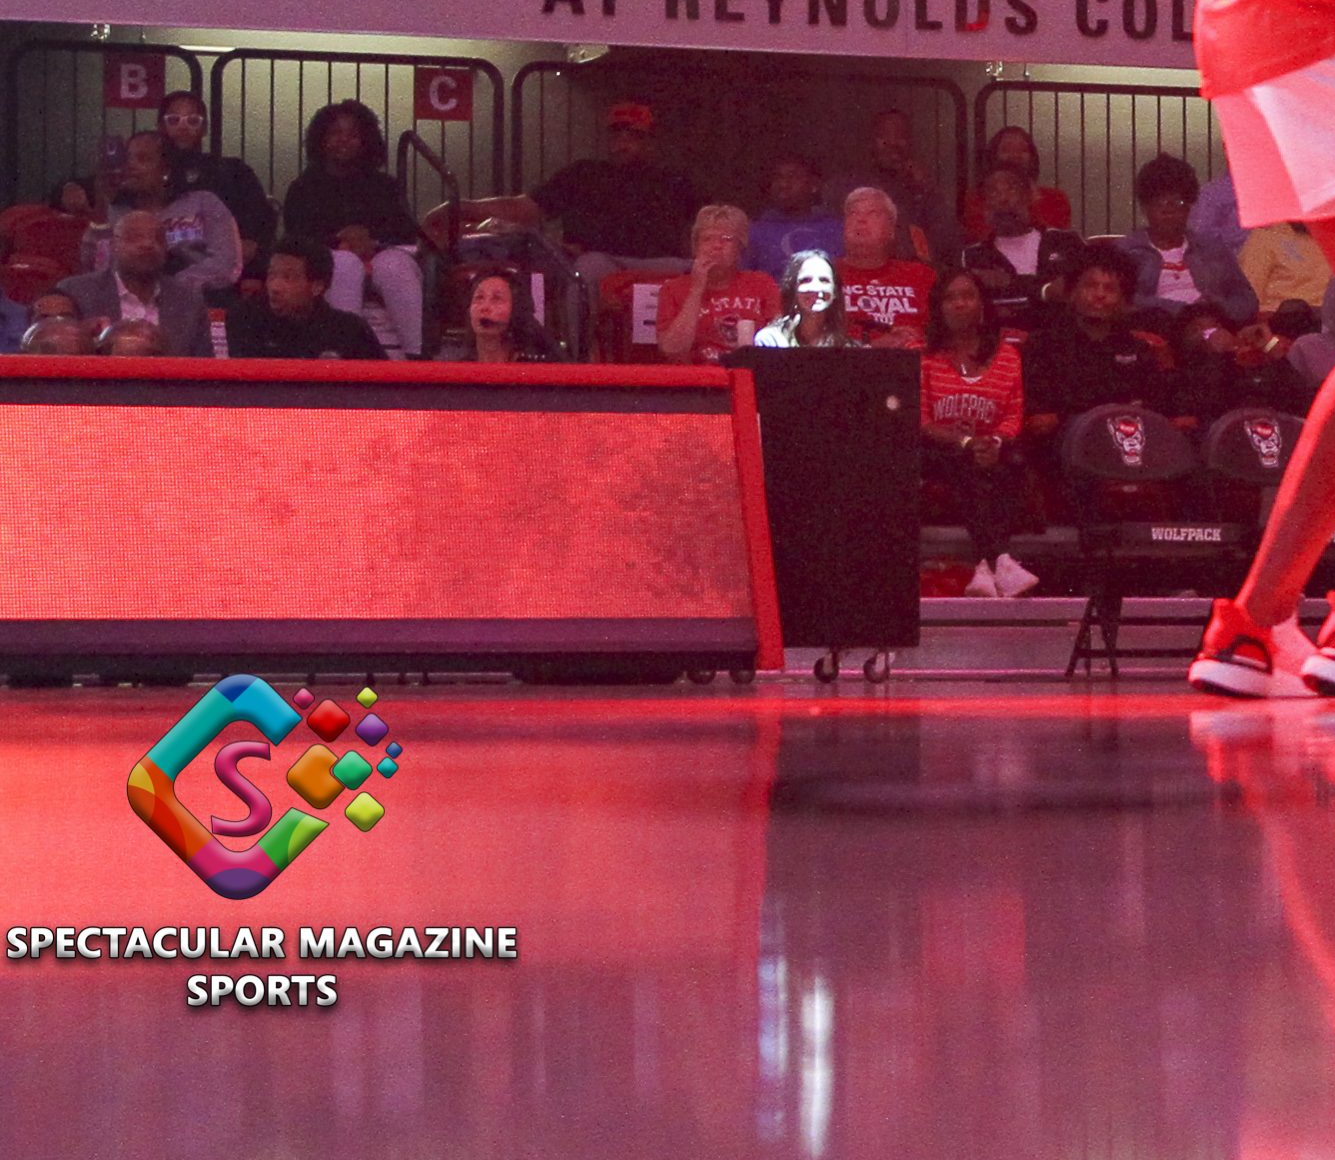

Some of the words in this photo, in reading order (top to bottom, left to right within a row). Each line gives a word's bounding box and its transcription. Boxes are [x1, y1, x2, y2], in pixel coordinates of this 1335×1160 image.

[121, 63, 149, 100] B
[429, 75, 458, 111] C
[866, 285, 915, 298] STATE
[846, 296, 918, 314] LOYAL
[1151, 527, 1222, 542] WOLFPACK
